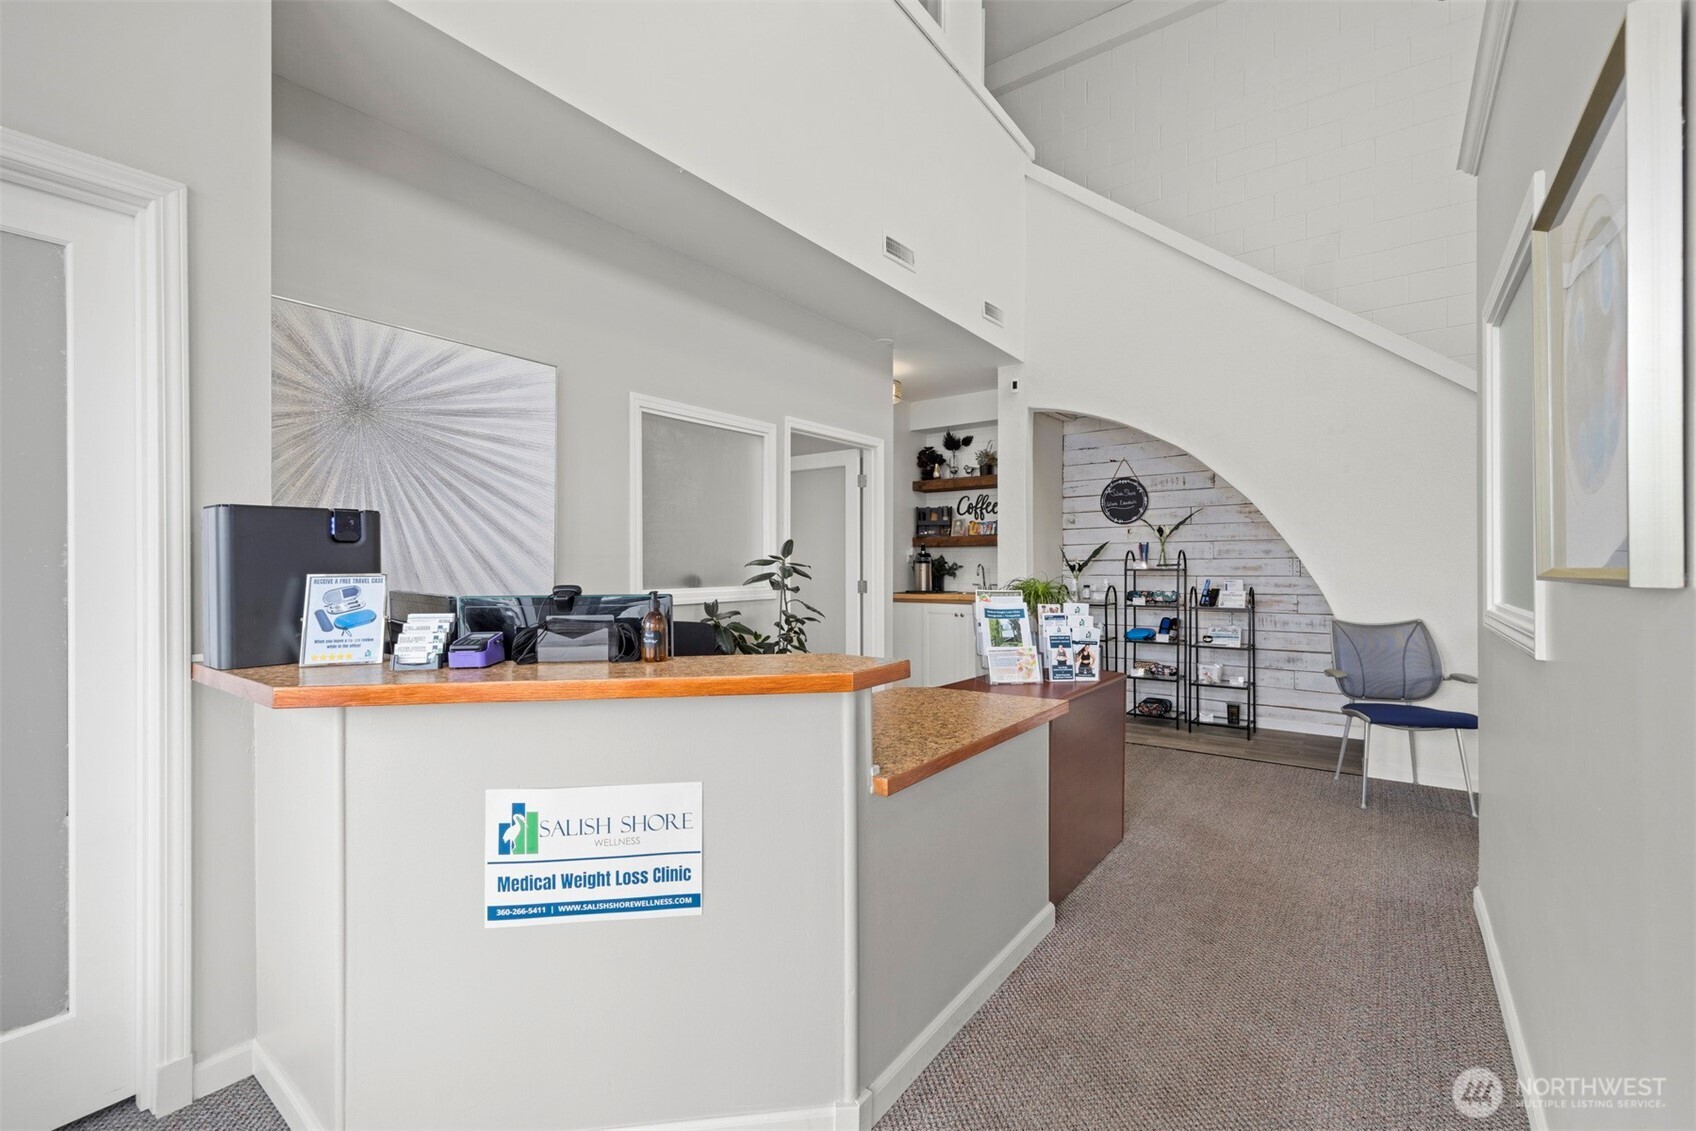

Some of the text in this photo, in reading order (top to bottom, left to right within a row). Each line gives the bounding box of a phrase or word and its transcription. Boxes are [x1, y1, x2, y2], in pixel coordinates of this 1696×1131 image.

[957, 494, 998, 520] Coffee
[539, 812, 694, 838] SALISH SHORE
[594, 836, 641, 847] WELLNESS
[497, 865, 692, 893] Medical Weight Loss Clinic
[496, 896, 693, 917] 360-266-5411 WWW.SALISHSHOREWELLNESS.COM
